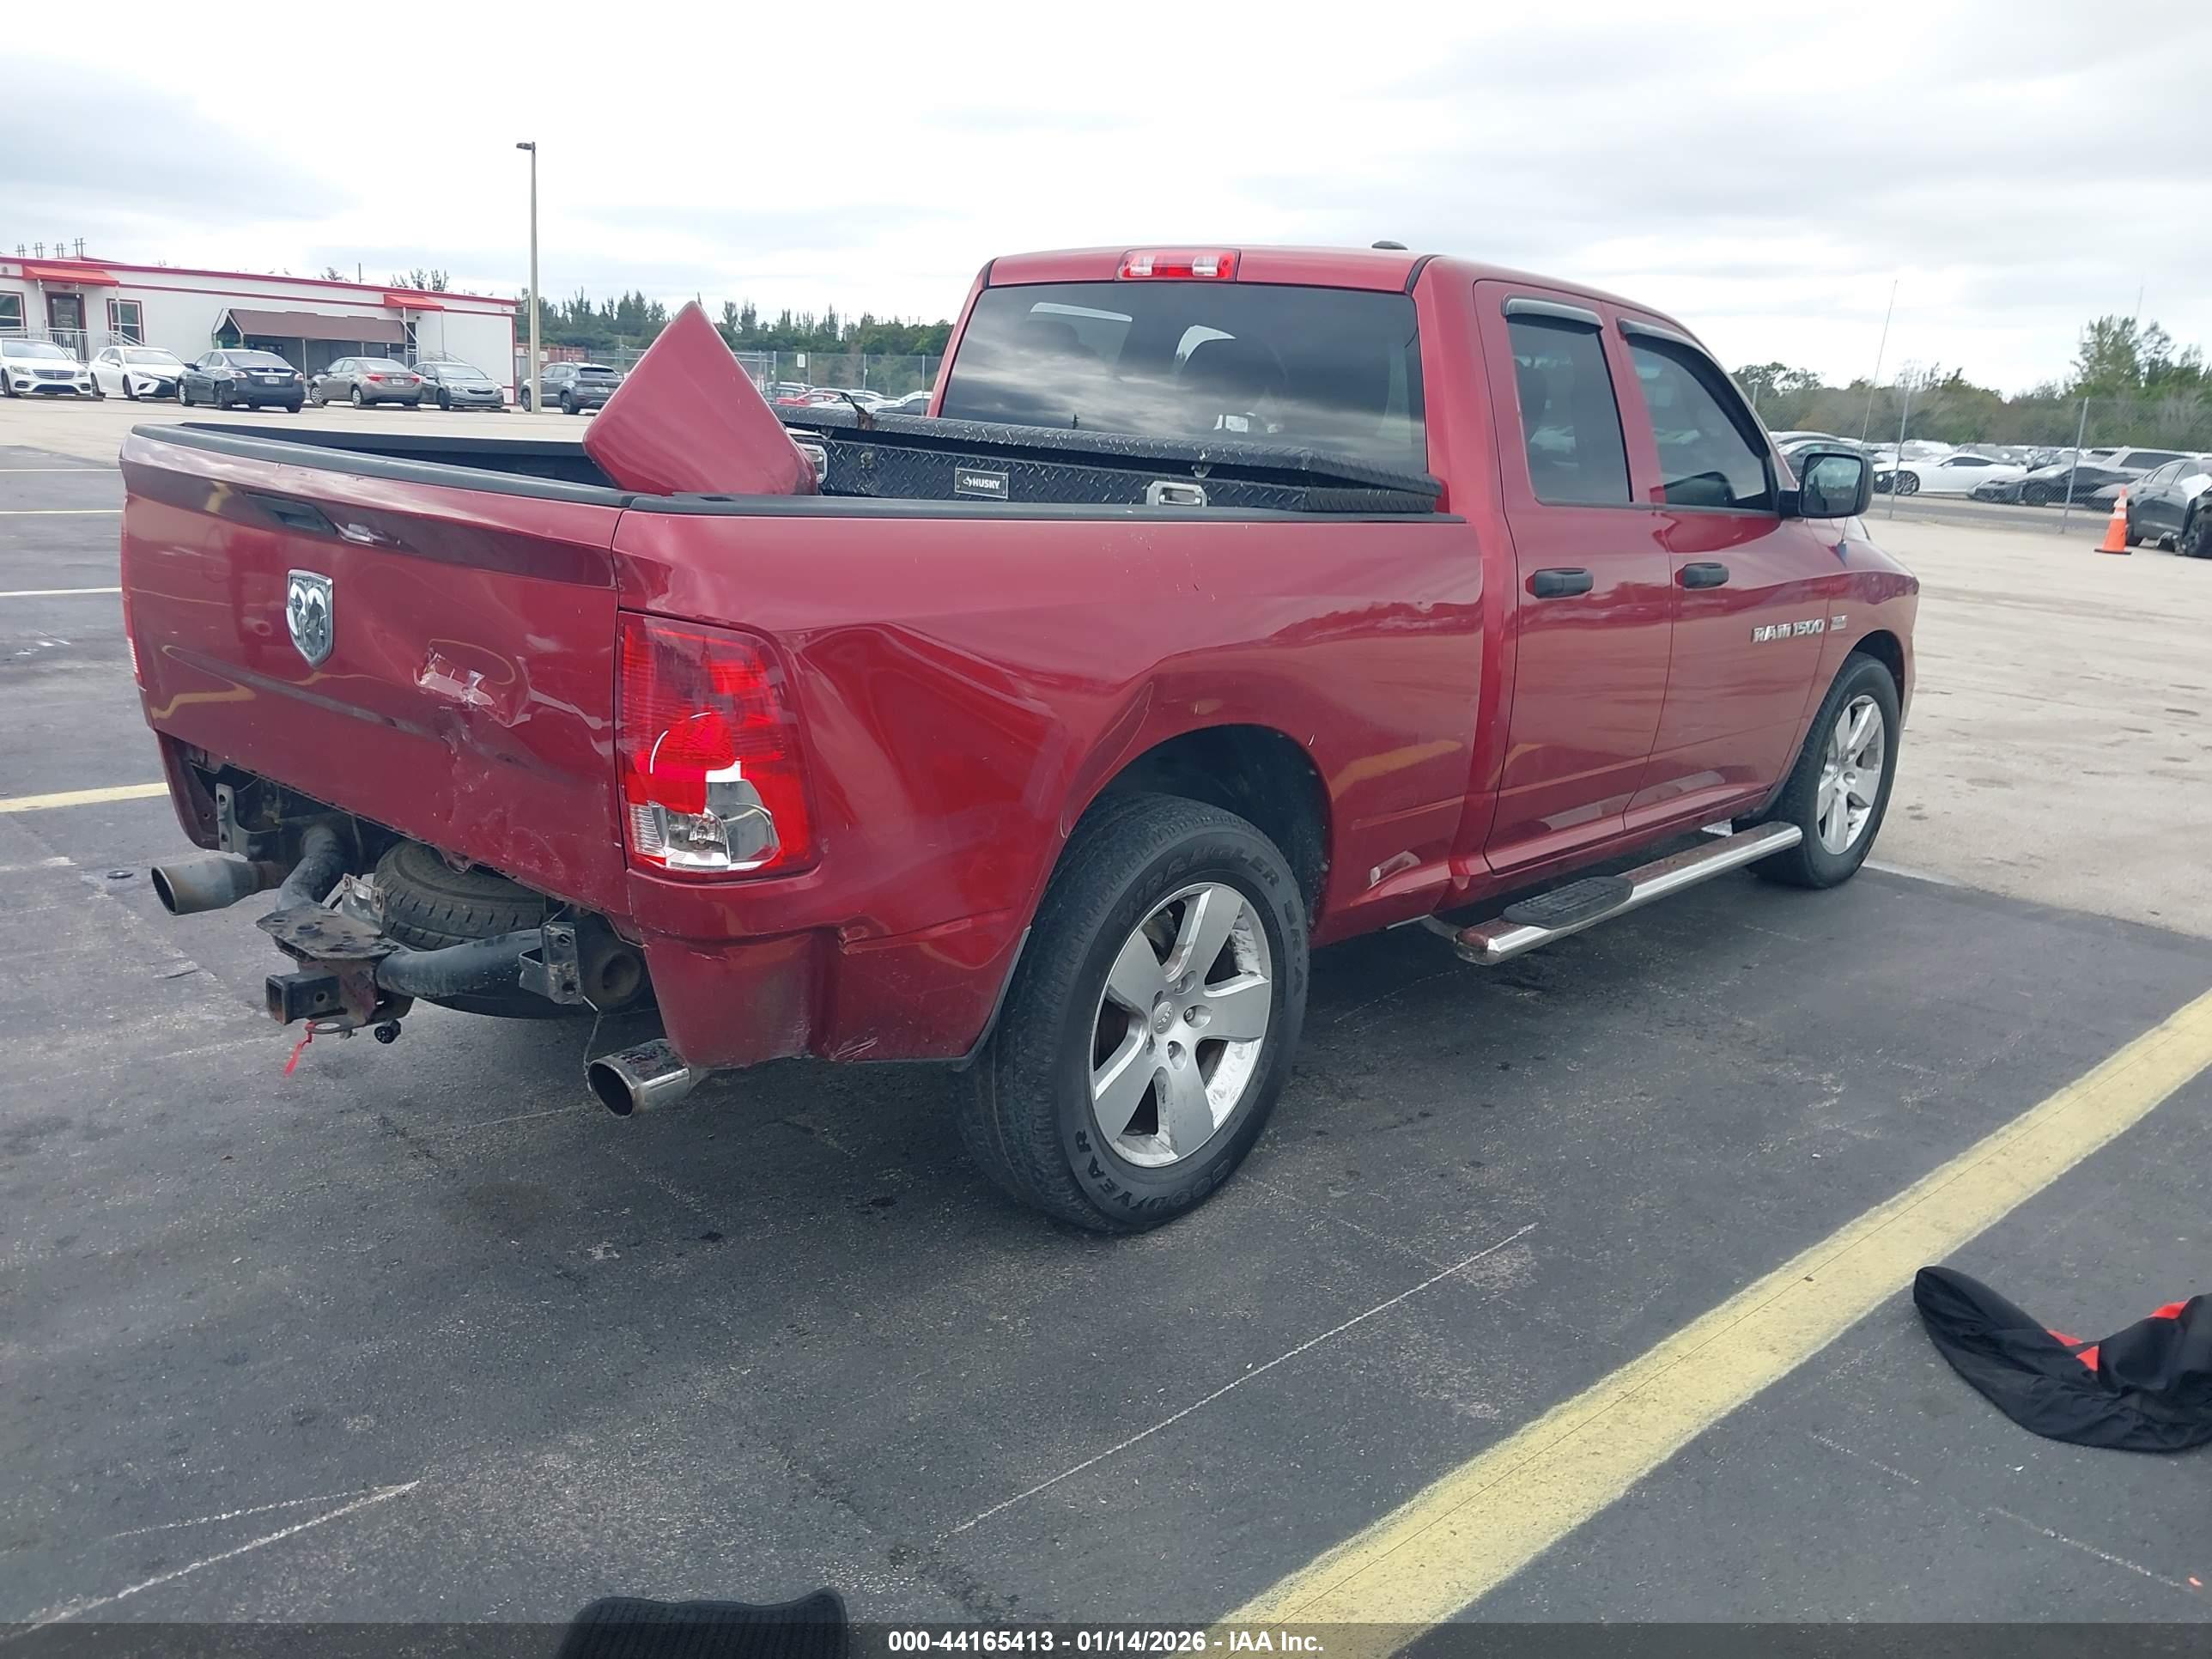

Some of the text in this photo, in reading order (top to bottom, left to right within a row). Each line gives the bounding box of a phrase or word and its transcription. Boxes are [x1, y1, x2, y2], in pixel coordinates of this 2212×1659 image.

[972, 477, 1000, 489] HUSKY
[1753, 623, 1791, 643] RAM
[1792, 618, 1826, 637] 1500
